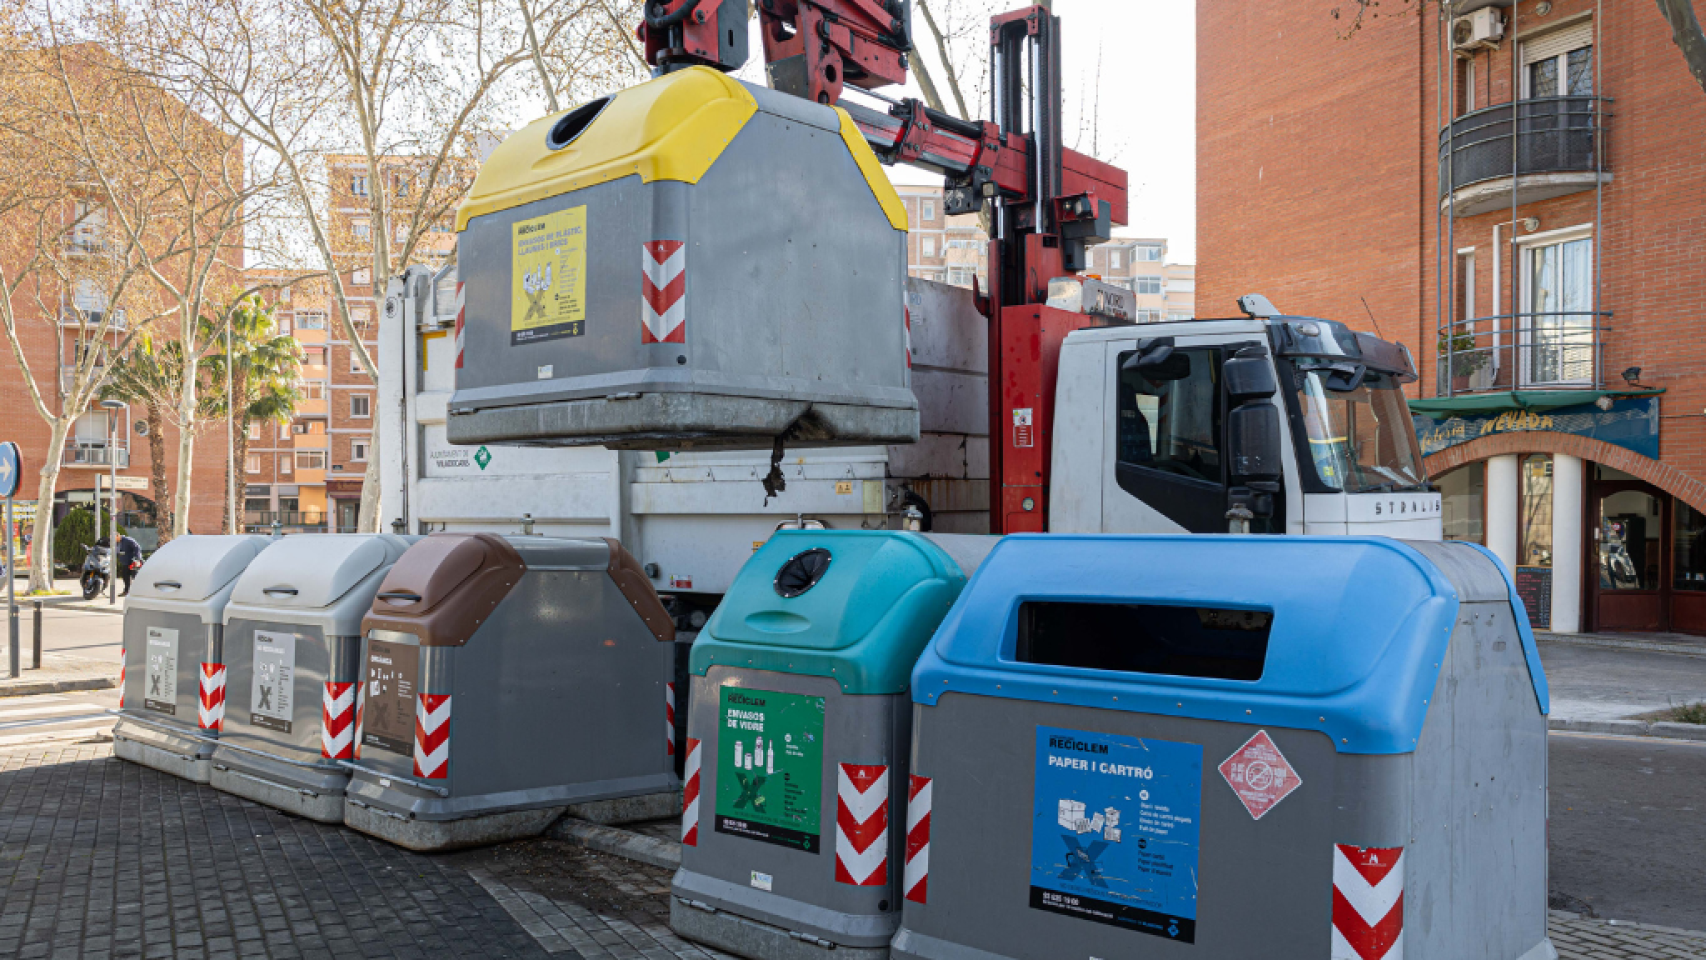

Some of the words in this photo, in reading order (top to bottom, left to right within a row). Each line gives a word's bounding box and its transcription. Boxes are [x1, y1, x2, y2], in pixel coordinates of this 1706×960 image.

[1420, 422, 1465, 456] feteria
[1480, 410, 1554, 435] NEVADA
[1375, 500, 1440, 515] STRALIS
[728, 693, 765, 706] RECICLEM
[728, 708, 764, 722] ENVASOS
[728, 719, 738, 729] DE
[740, 721, 764, 732] VIDRE
[1049, 738, 1109, 755] RECICLEM
[1049, 755, 1089, 771] PAPER
[1092, 761, 1096, 772] I
[1099, 762, 1154, 780] CARTRÓ
